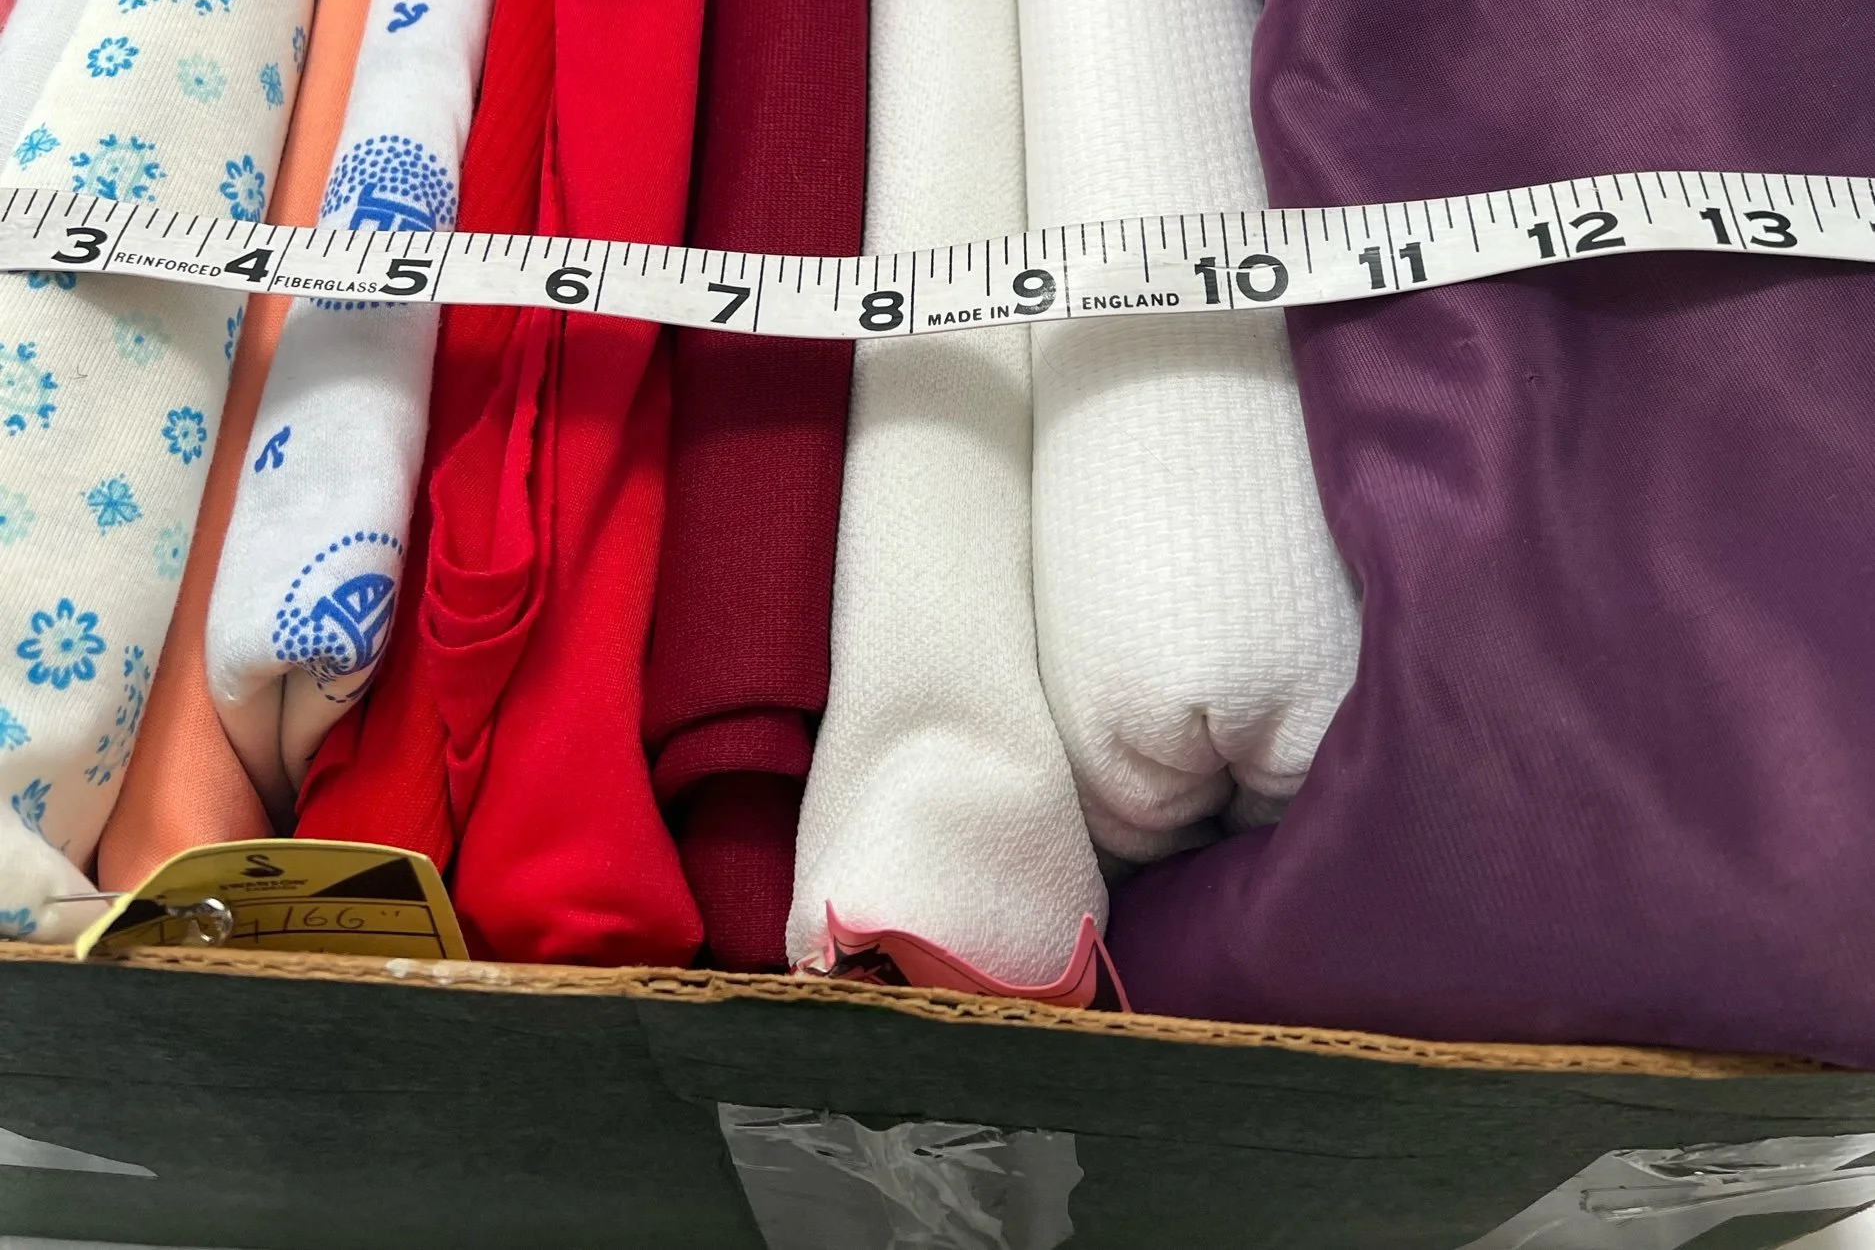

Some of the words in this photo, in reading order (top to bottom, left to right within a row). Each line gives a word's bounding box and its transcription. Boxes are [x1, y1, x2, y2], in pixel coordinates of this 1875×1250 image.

[51, 227, 108, 264] 3
[113, 251, 222, 277] REINFORCED
[223, 248, 273, 283] 4
[274, 275, 378, 295] FIBERGLASS
[378, 258, 432, 296] 5
[545, 266, 593, 305] 6
[707, 282, 751, 324] 7
[858, 290, 905, 332] 8
[927, 308, 983, 327] MADE
[990, 305, 1010, 319] IN
[1012, 268, 1057, 316] 9
[1081, 292, 1180, 311] ENGLAND
[1194, 255, 1289, 305] 10
[1358, 241, 1428, 290] 11
[1527, 211, 1626, 259] 12
[1699, 207, 1798, 249] 13
